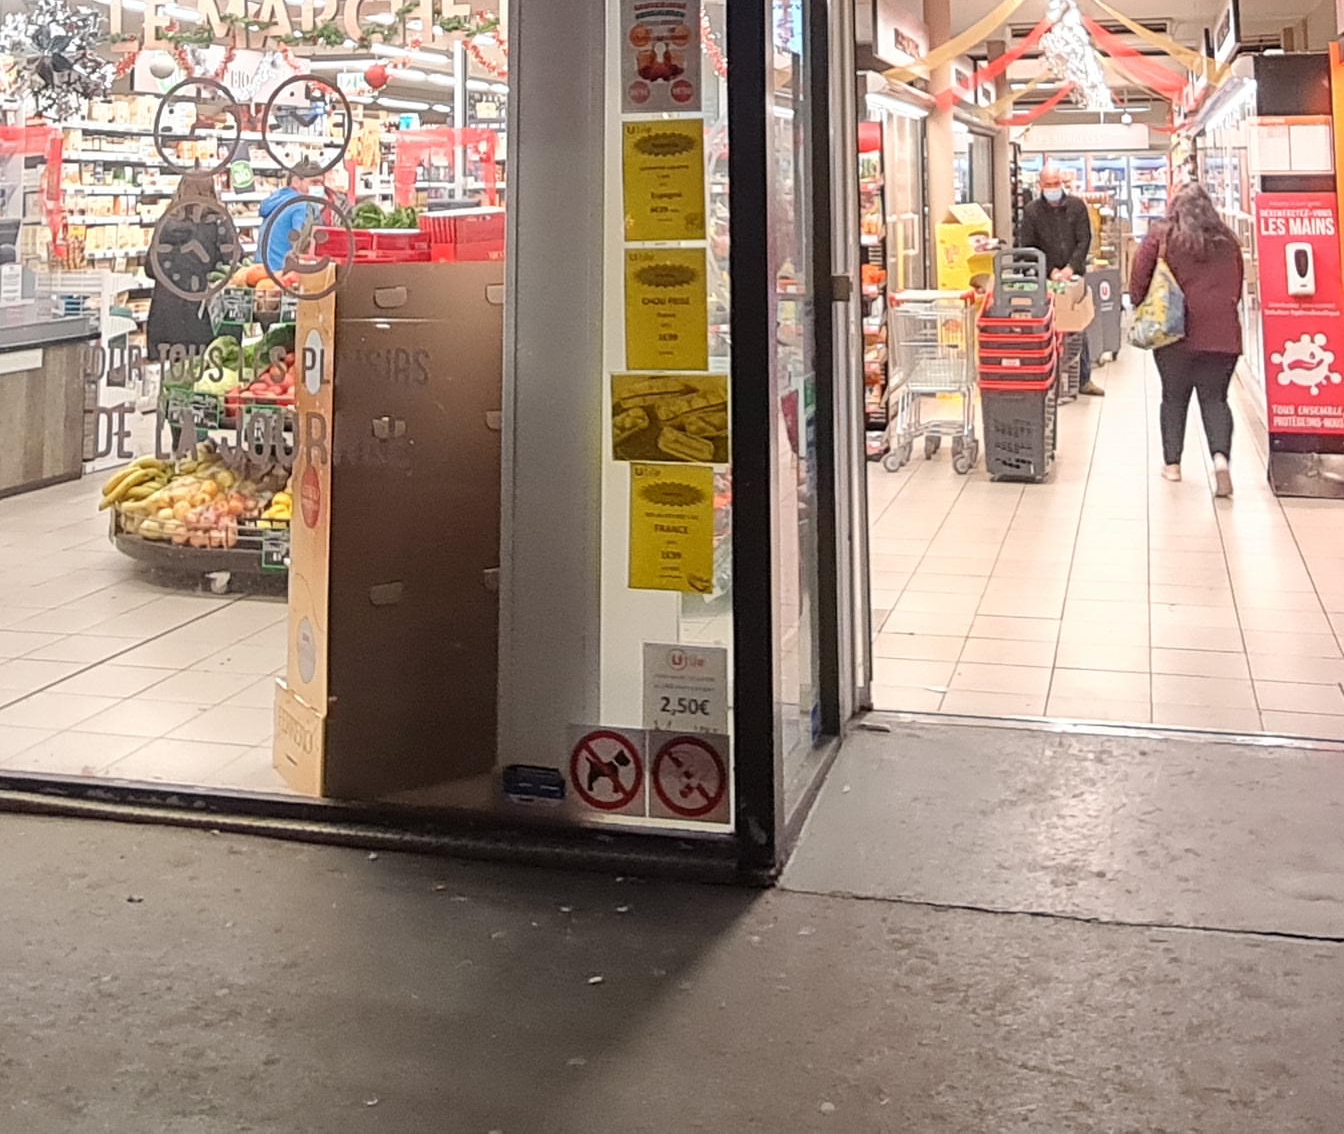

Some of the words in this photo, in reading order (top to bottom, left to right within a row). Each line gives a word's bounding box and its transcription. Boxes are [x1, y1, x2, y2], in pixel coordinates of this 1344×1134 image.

[1260, 218, 1286, 236] LES
[1289, 217, 1335, 236] MAINS
[158, 343, 224, 384] TOUS
[238, 345, 288, 384] LES
[1272, 404, 1295, 415] TOUS
[93, 406, 135, 459] DE
[155, 408, 198, 462] LA
[660, 696, 711, 716] 2,50€
